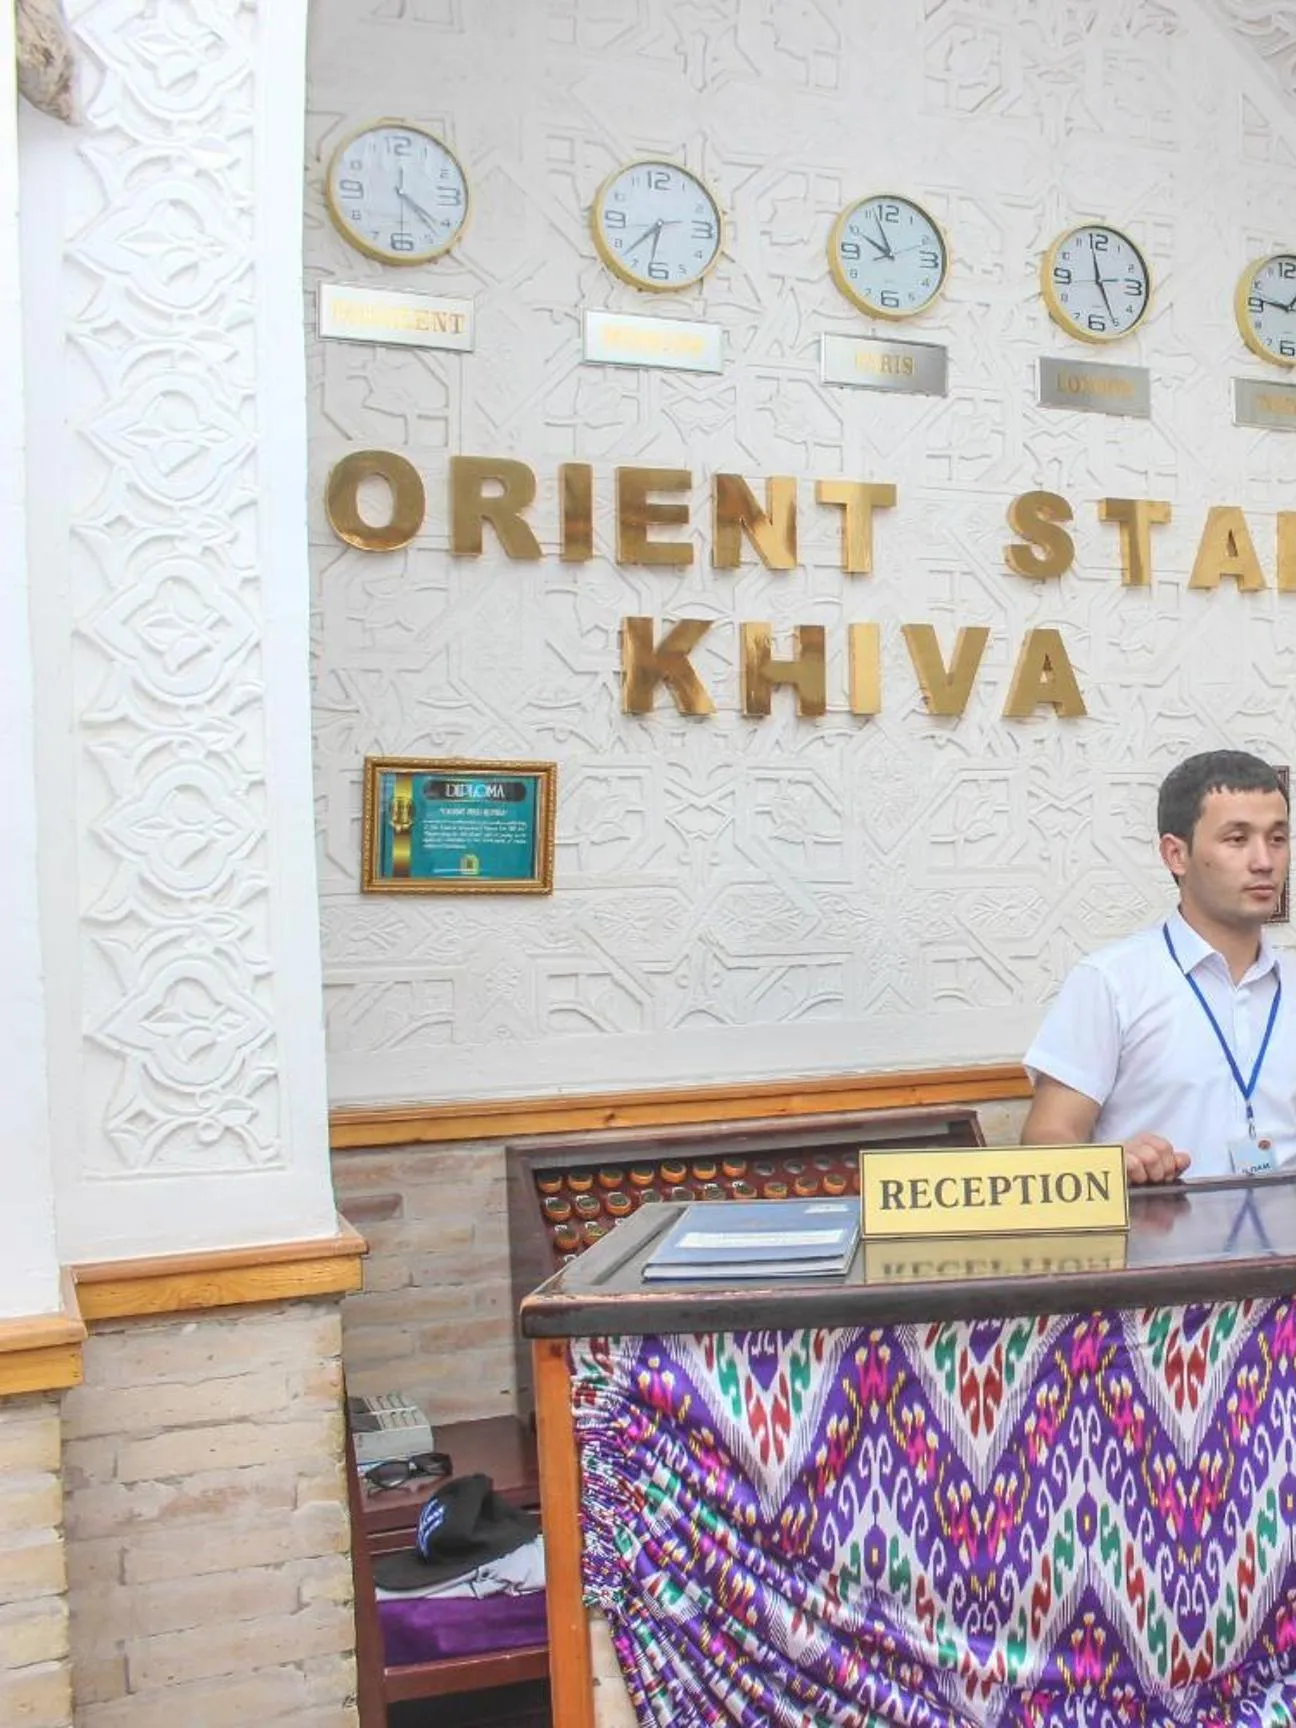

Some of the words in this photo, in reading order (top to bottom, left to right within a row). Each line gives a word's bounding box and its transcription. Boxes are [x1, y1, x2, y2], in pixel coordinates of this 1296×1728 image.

[340, 180, 364, 199] 9
[647, 171, 671, 191] 12
[436, 185, 460, 206] 3
[605, 210, 626, 228] 9
[878, 204, 899, 223] 12
[691, 220, 713, 239] 3
[390, 233, 414, 251] 6
[841, 242, 860, 260] 9
[1089, 233, 1109, 251] 12
[919, 250, 939, 268] 3
[648, 262, 669, 280] 6
[1054, 267, 1072, 285] 9
[1278, 262, 1296, 279] 12
[1123, 278, 1142, 296] 3
[881, 290, 899, 308] 6
[1248, 297, 1264, 313] 9
[1088, 314, 1105, 331] 6
[1280, 340, 1295, 356] 6
[324, 449, 897, 573] ORIENT
[621, 616, 1088, 717] KHIVA
[880, 1171, 1110, 1210] RECEPTION
